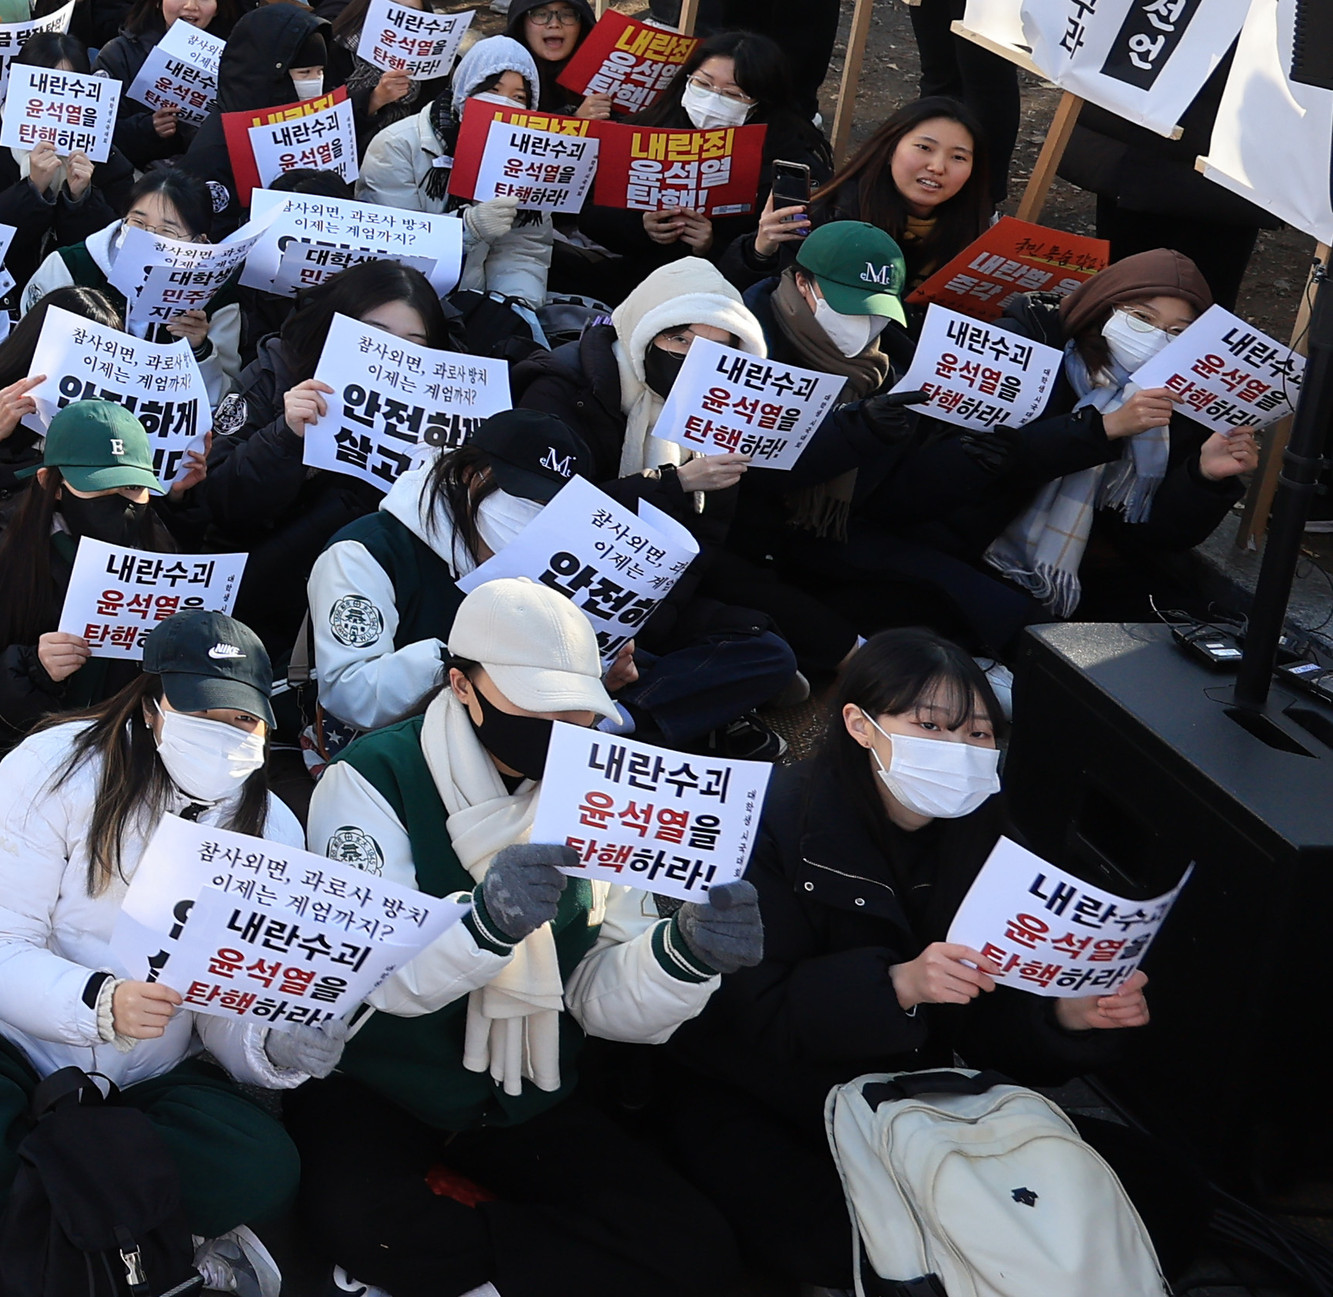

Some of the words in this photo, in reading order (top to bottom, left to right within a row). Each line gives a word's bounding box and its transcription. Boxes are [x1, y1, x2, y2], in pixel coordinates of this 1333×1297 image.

[385, 7, 457, 36] 내란수괴
[29, 70, 102, 104] 내란수괴
[508, 132, 587, 163] 내란수괴
[630, 128, 735, 161] 내란죄
[626, 159, 731, 190] 윤석열
[71, 325, 141, 368] 참사외면,
[356, 334, 425, 374] 참사외면,
[945, 319, 1033, 371] 내란수괴
[82, 354, 131, 379] 이제는
[134, 365, 192, 393] 계엄까지?
[367, 363, 415, 393] 이제는
[423, 382, 478, 406] 계엄까지?
[715, 354, 821, 401] 내란수괴
[934, 351, 1023, 402] 윤석열을
[1188, 351, 1289, 411] 윤석열을
[700, 385, 802, 433] 윤석열을
[110, 438, 125, 455] E
[105, 553, 213, 589] 내란수괴
[215, 643, 241, 658] NIKE
[587, 740, 731, 806] 내란수괴
[576, 790, 723, 852] 윤석열을
[197, 840, 292, 887] 참사외면,
[299, 869, 375, 909] 과로사
[380, 897, 431, 928] 방치
[211, 872, 281, 907] 이제는
[285, 893, 397, 943] 계엄까지?
[227, 906, 374, 975] 내란수괴
[1004, 910, 1148, 966] 윤석열을
[208, 946, 347, 1005] 윤석열을
